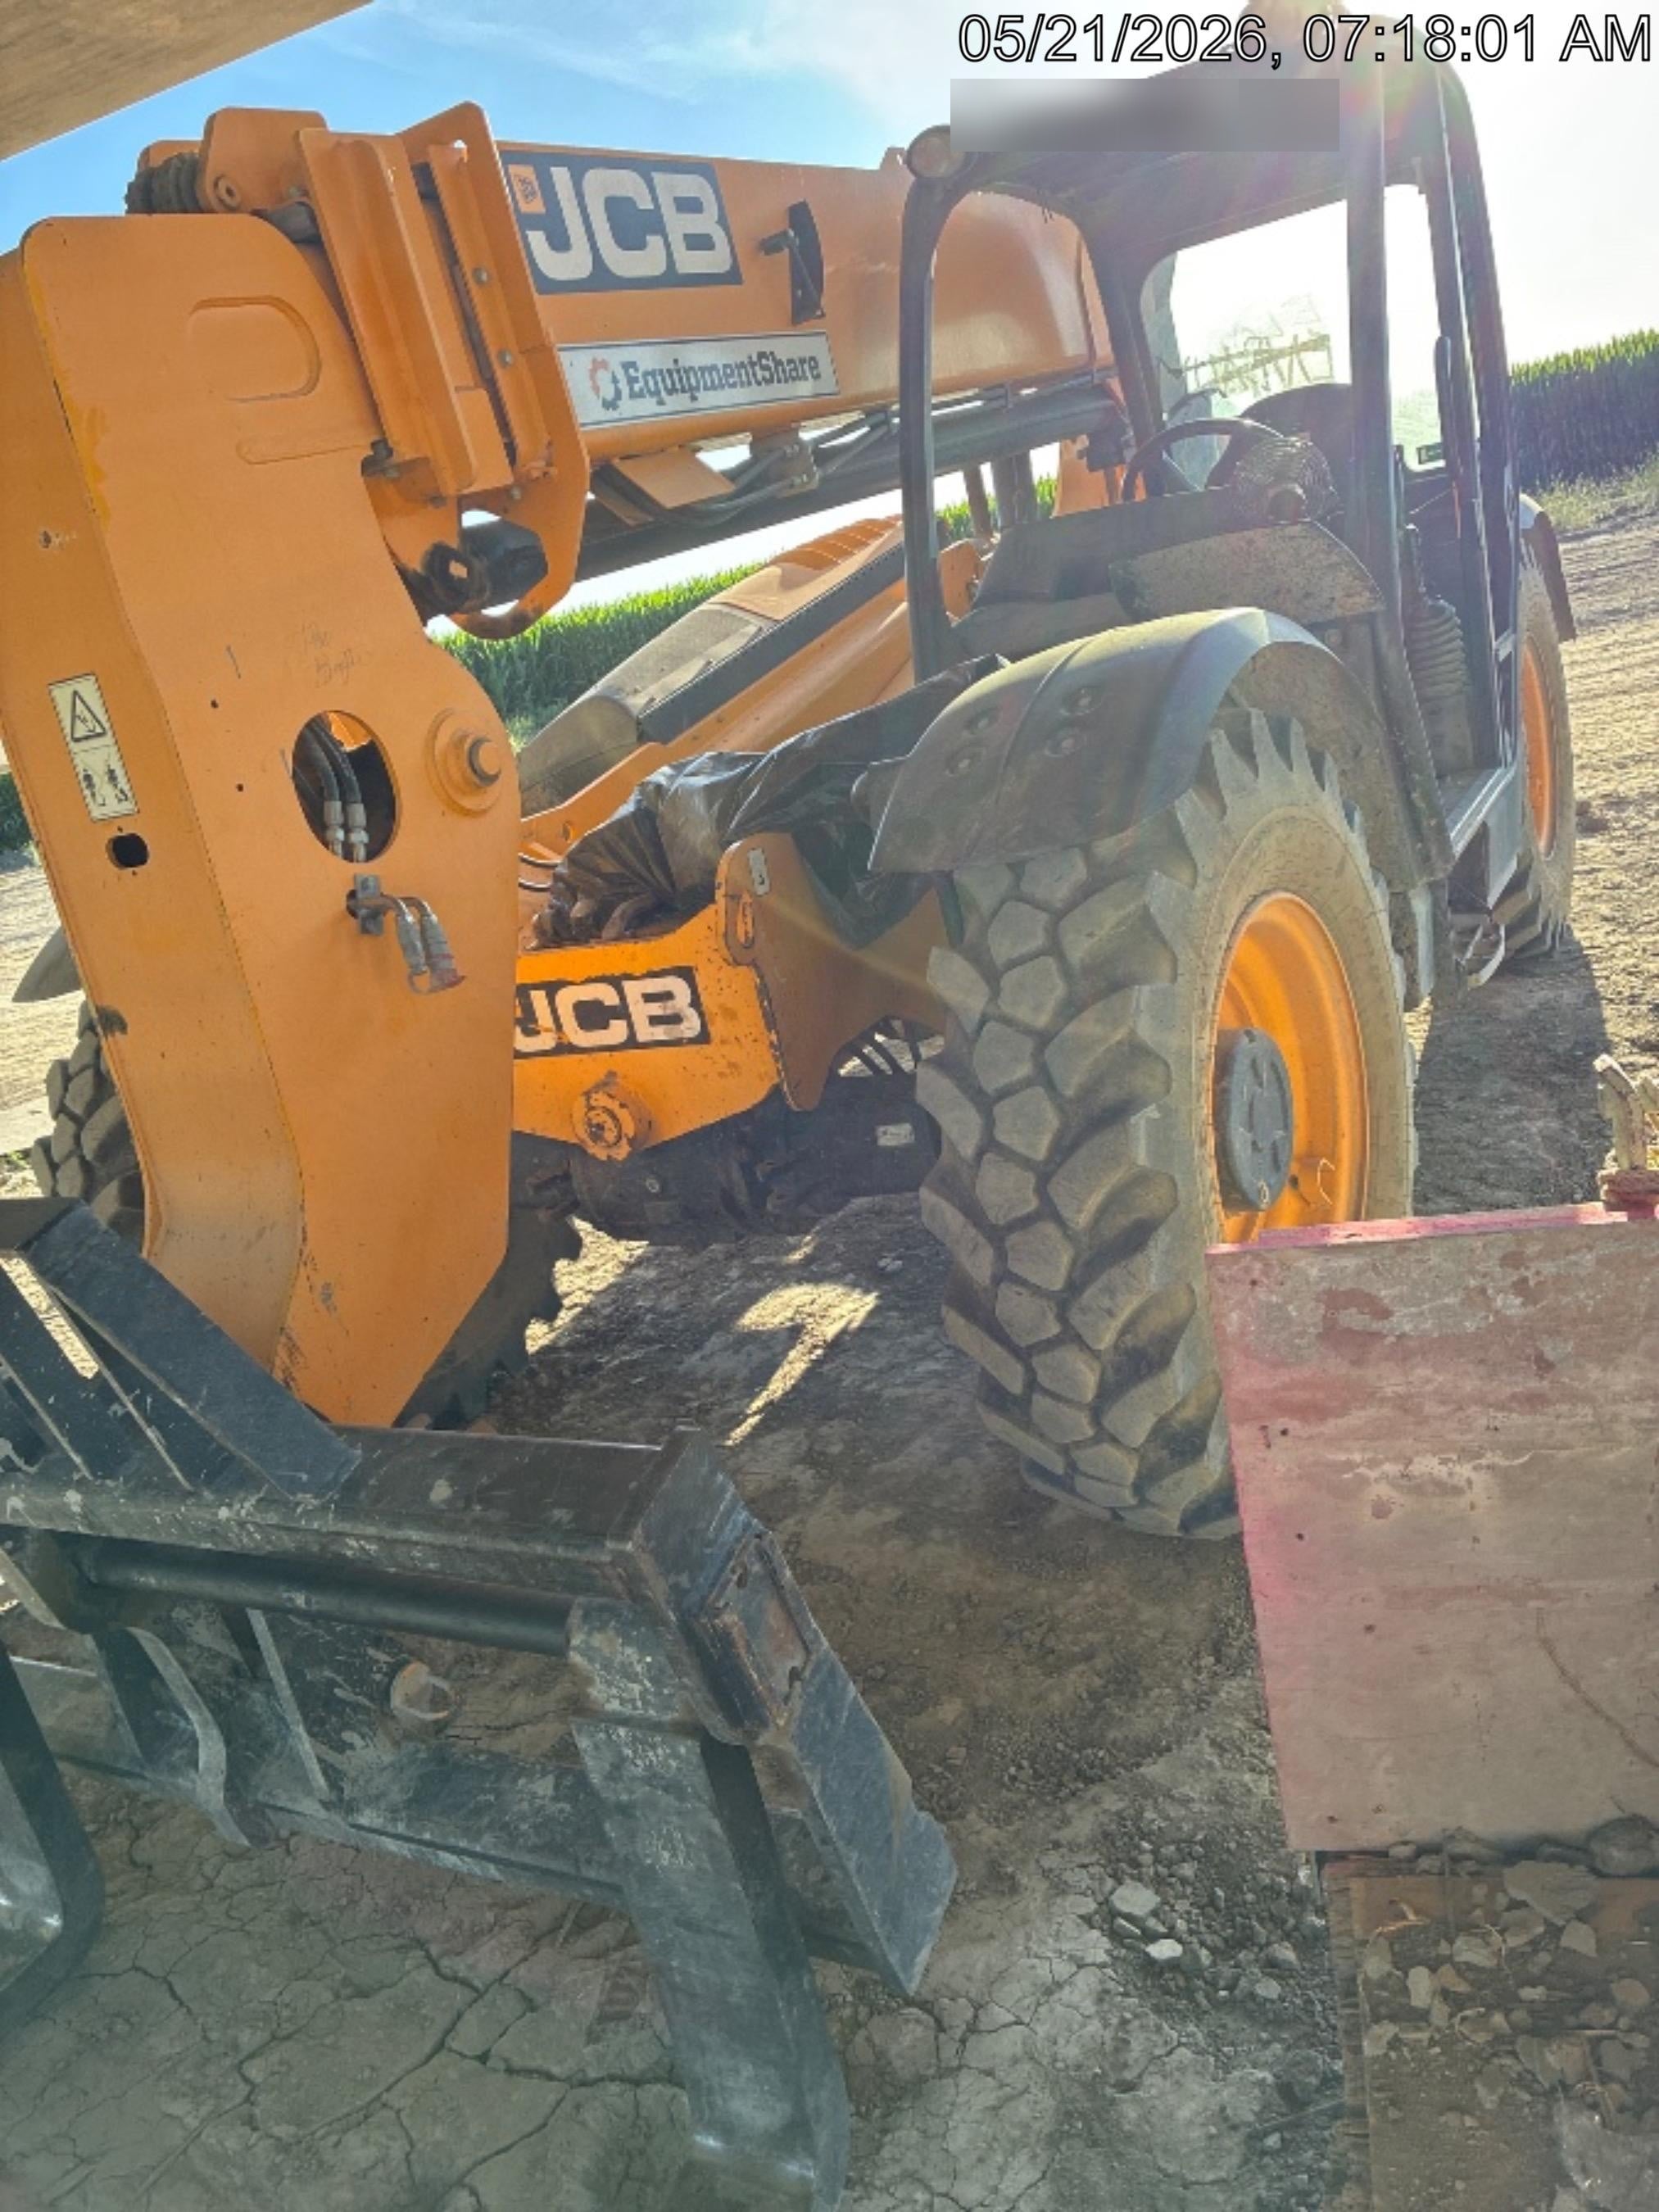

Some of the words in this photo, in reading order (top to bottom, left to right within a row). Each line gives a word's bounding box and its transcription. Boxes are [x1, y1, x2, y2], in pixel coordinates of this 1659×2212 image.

[526, 166, 733, 281] JCB
[624, 351, 822, 406] EquipmentShare
[514, 976, 701, 1053] JCB
